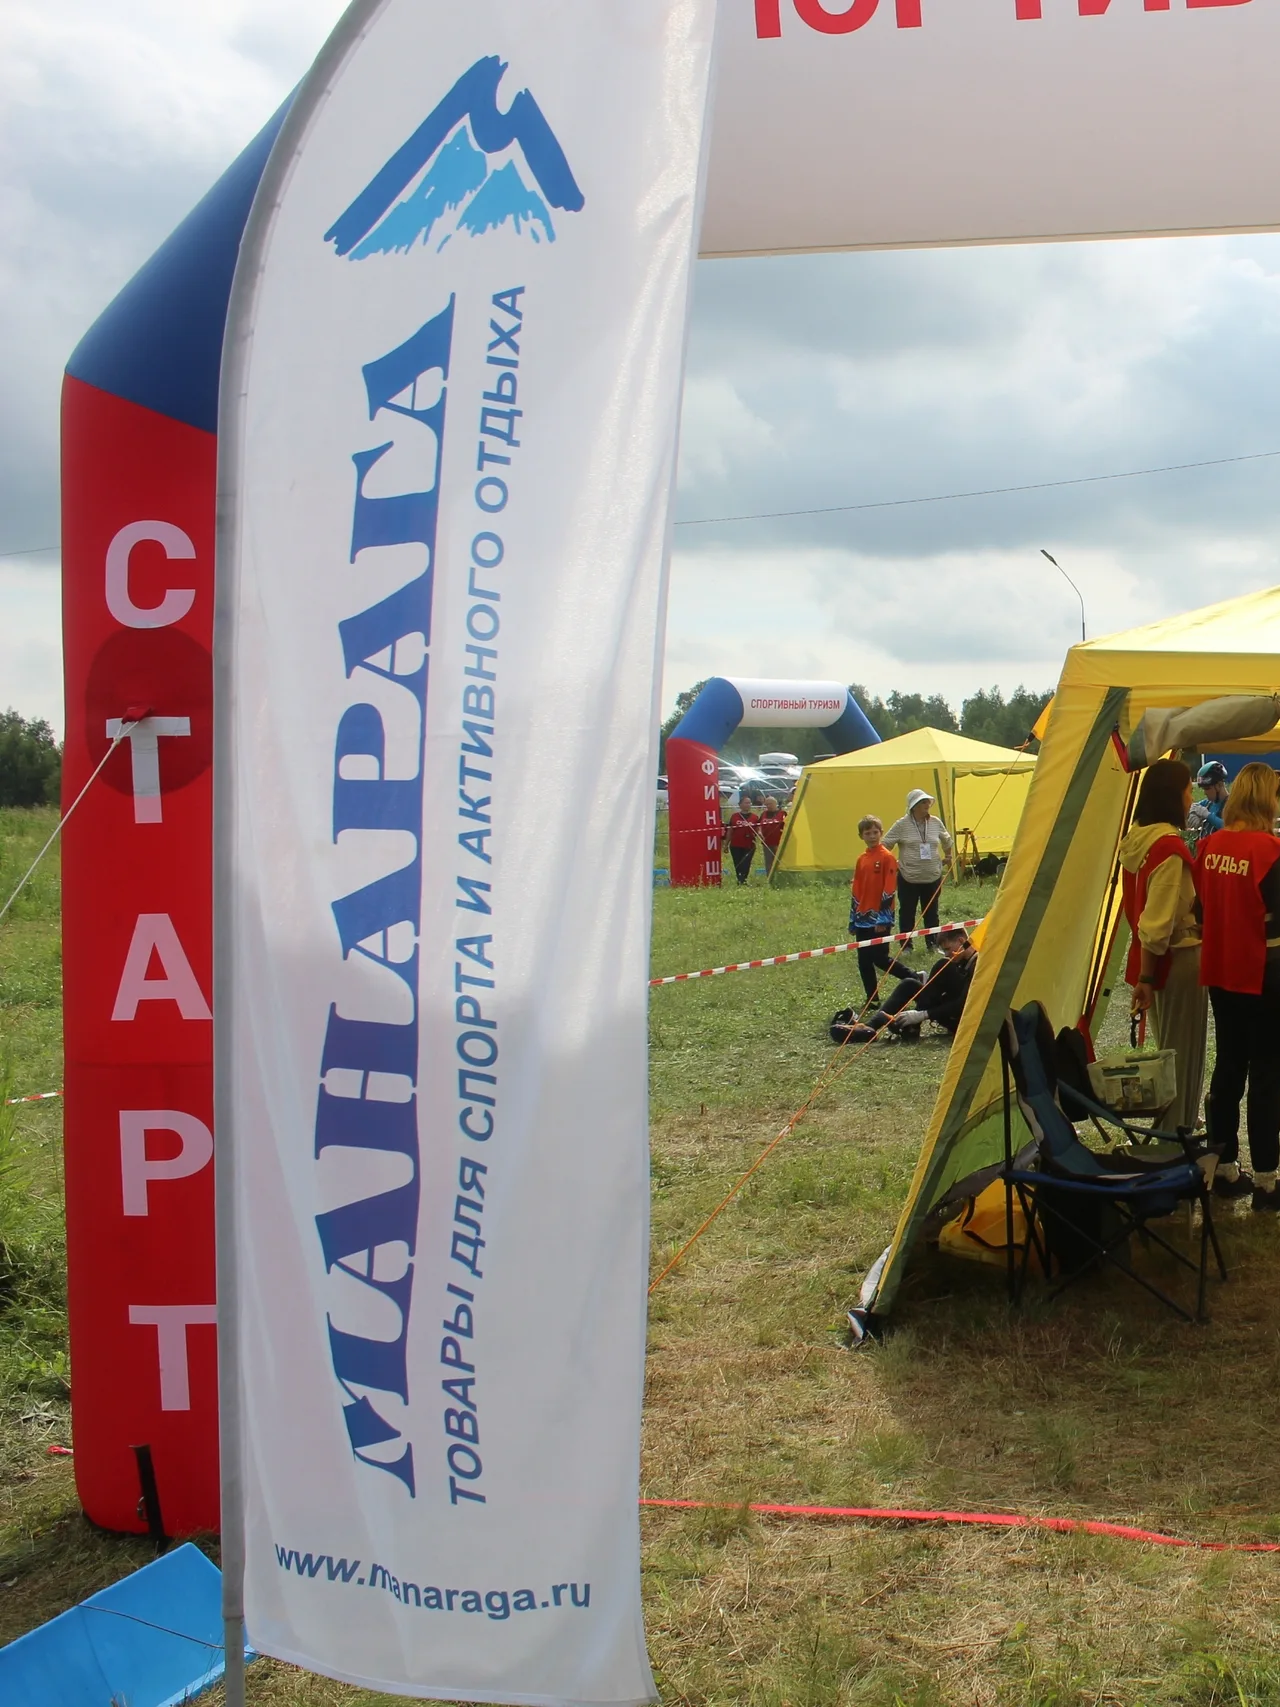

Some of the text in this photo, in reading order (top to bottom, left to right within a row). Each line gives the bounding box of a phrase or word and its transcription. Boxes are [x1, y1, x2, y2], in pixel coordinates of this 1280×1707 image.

[751, 697, 840, 710] СПОРТИВНЫЙ ТУРИЗМ
[701, 759, 720, 876] ФИНИШ
[1203, 852, 1250, 877] СУДЬЯ
[314, 291, 456, 1498] МАНАРАГА
[440, 284, 526, 1506] ТОВАРЫ ДЛЯ СПОРТА И АКТИВНОГО ОТДЫХА
[104, 519, 217, 1412] СТАРТ
[274, 1543, 592, 1622] www.manaraga.ru
